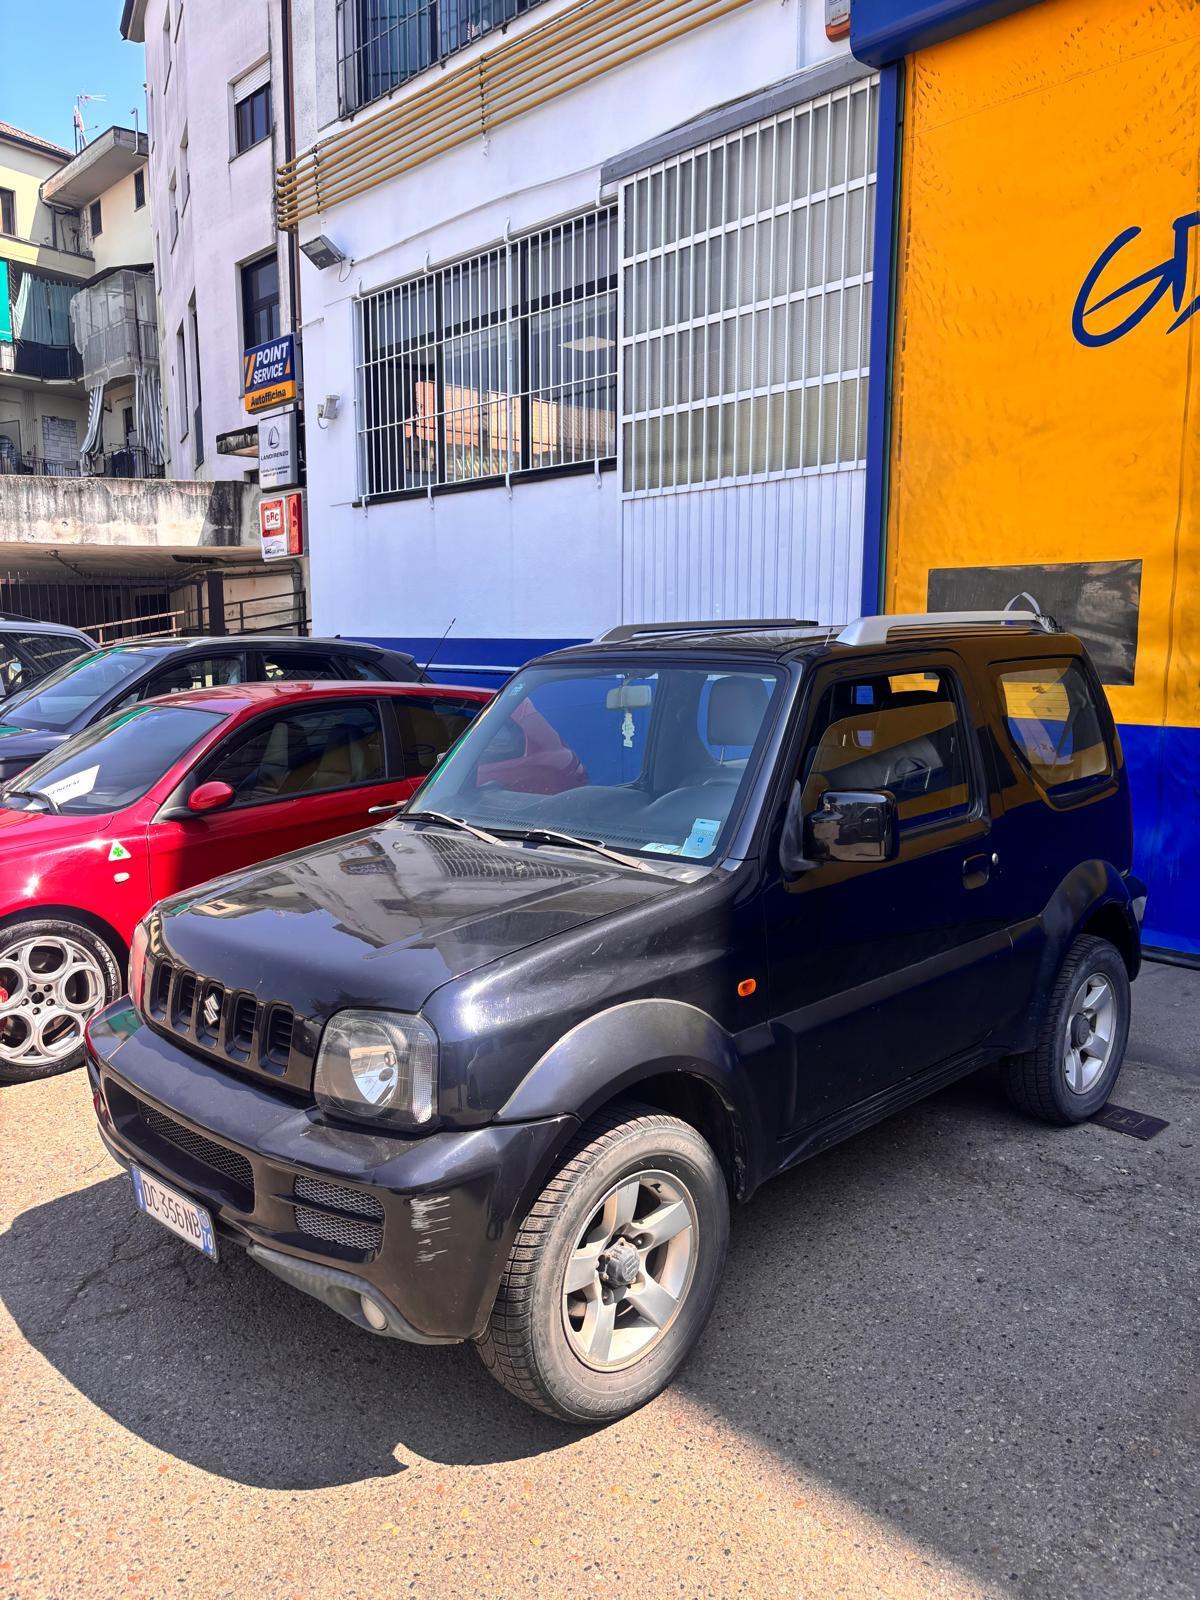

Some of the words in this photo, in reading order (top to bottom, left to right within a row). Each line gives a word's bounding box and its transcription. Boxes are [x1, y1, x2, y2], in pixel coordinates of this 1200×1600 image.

[256, 341, 289, 367] POINT
[254, 362, 284, 385] SERVICE
[251, 388, 287, 408] Autofficina
[266, 512, 280, 524] BRC
[143, 1179, 202, 1240] DC356NB
[203, 1230, 214, 1250] TO
